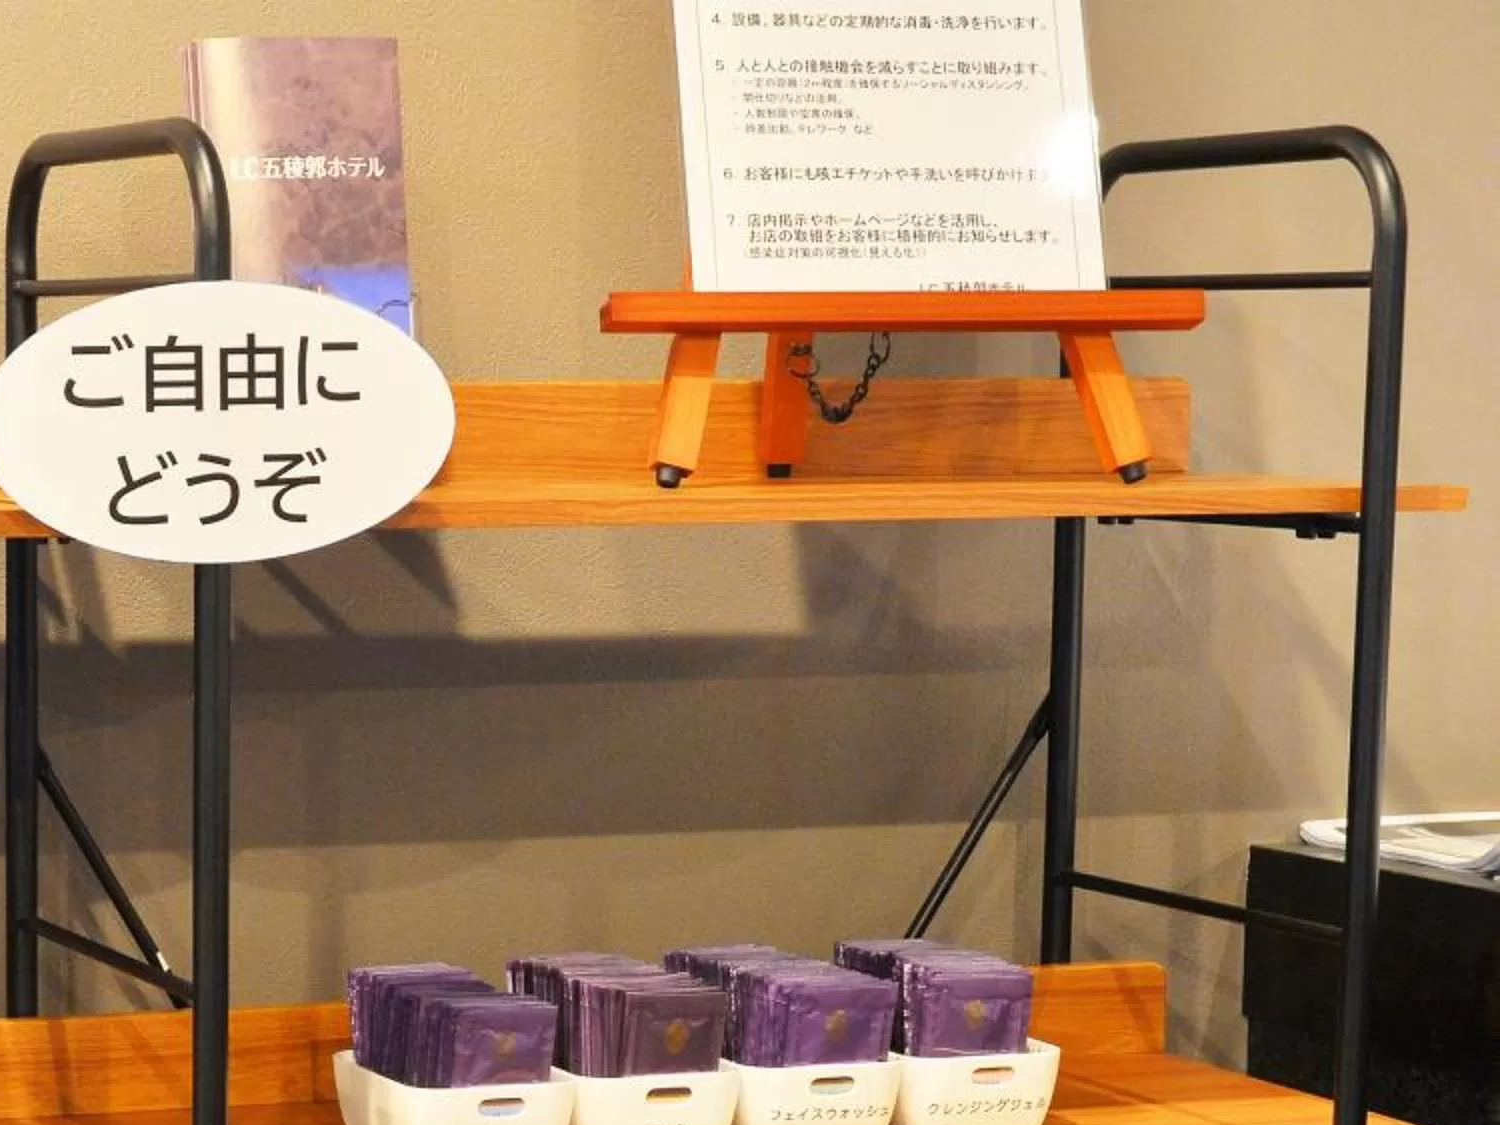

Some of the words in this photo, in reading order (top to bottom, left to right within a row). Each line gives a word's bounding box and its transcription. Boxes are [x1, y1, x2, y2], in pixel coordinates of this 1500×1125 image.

[64, 334, 361, 413] ご自由に
[108, 448, 327, 526] どうぞ
